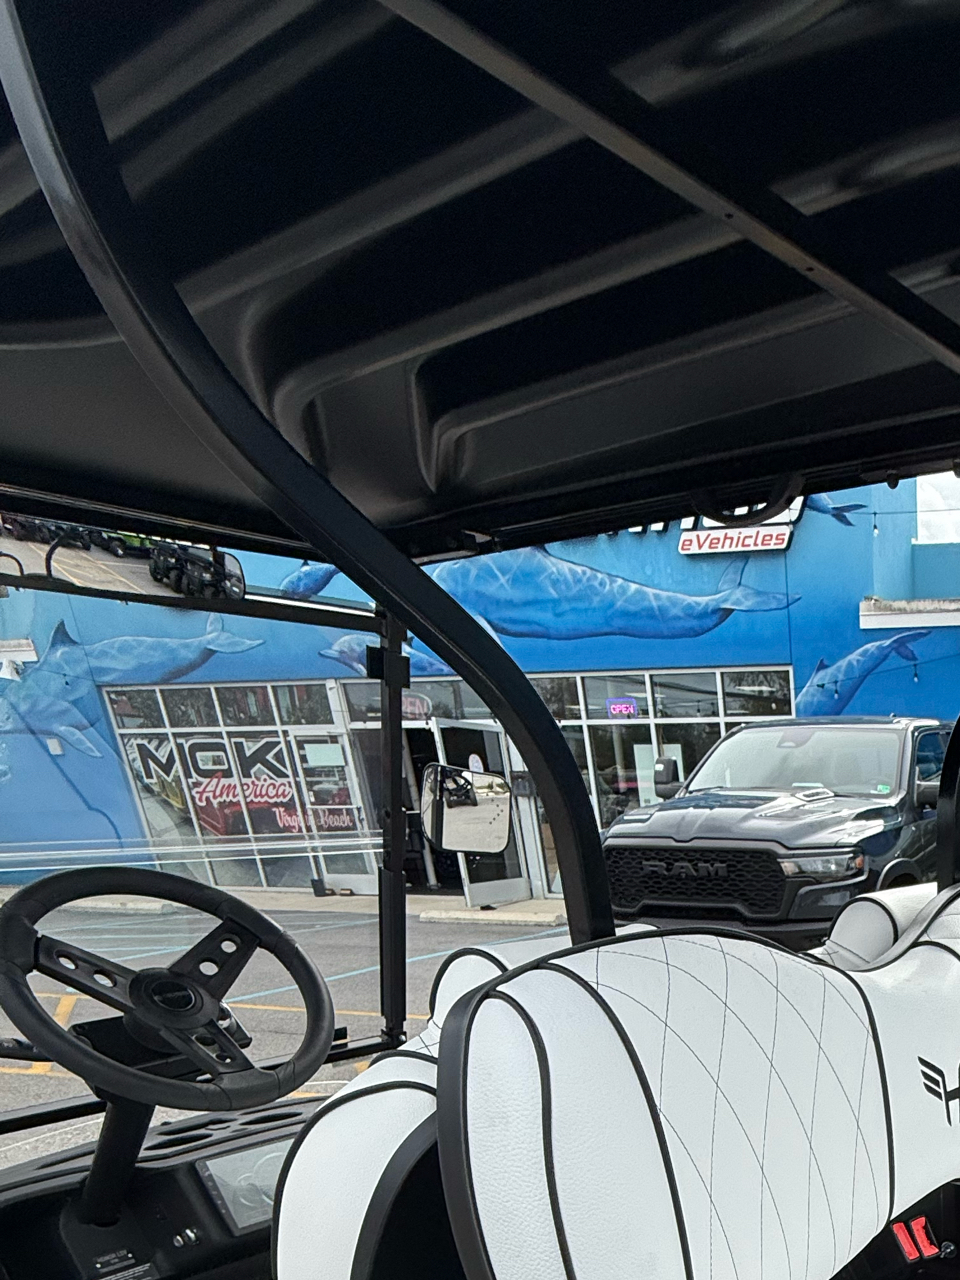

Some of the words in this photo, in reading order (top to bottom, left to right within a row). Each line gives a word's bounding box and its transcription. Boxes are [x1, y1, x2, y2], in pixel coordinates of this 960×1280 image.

[681, 531, 786, 551] eVehicles
[610, 704, 634, 714] OPEN
[195, 771, 293, 804] America
[318, 808, 353, 828] Beach
[642, 861, 728, 877] RAM
